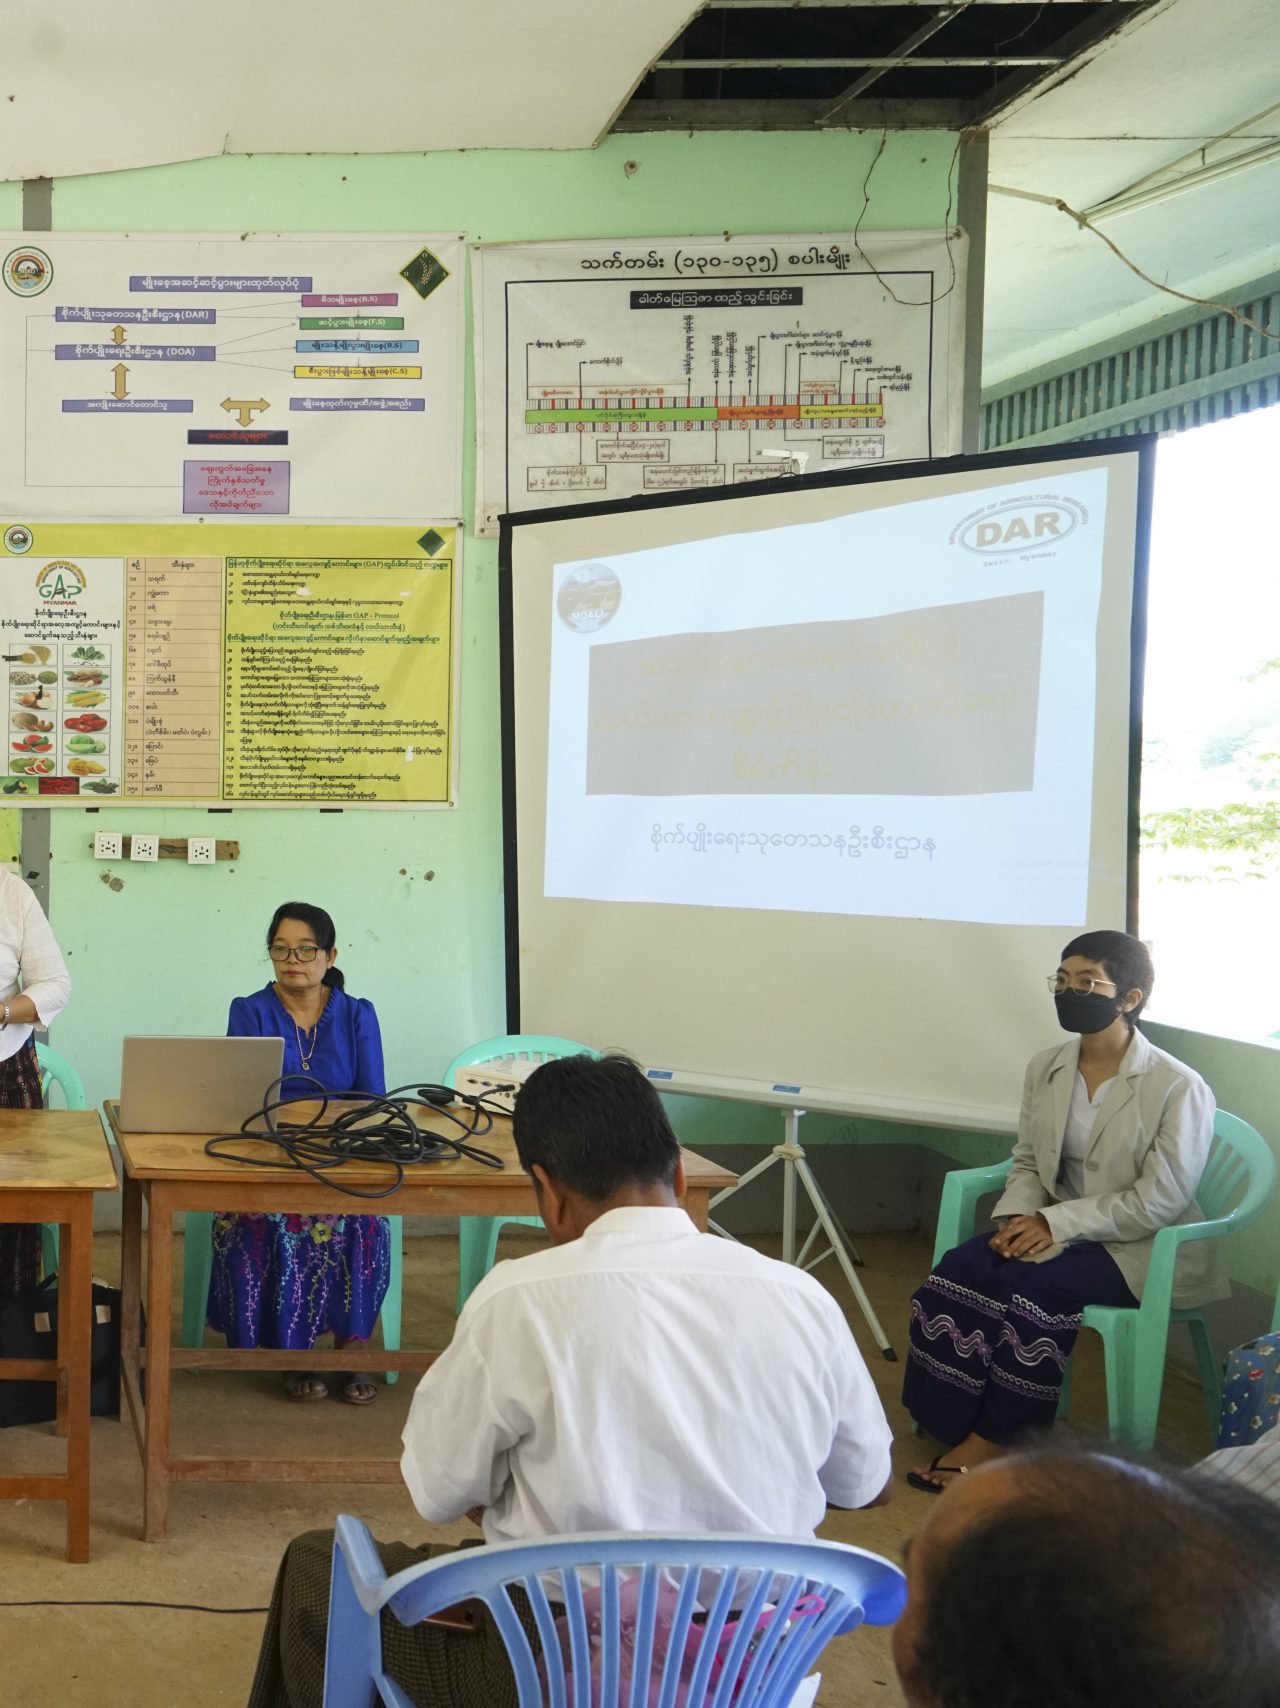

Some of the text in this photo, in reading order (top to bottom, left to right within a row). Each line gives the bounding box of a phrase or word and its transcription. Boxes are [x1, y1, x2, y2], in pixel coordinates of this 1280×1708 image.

[580, 250, 665, 269] သက်တမ်း
[788, 245, 851, 270] စပါးမျိုး
[166, 346, 195, 357] (DOA)
[976, 511, 1061, 548] DAR
[39, 574, 82, 600] GAP
[650, 821, 938, 861] စိုက်ပျိုးရေးသုတေသနဦးစီးဌာန
